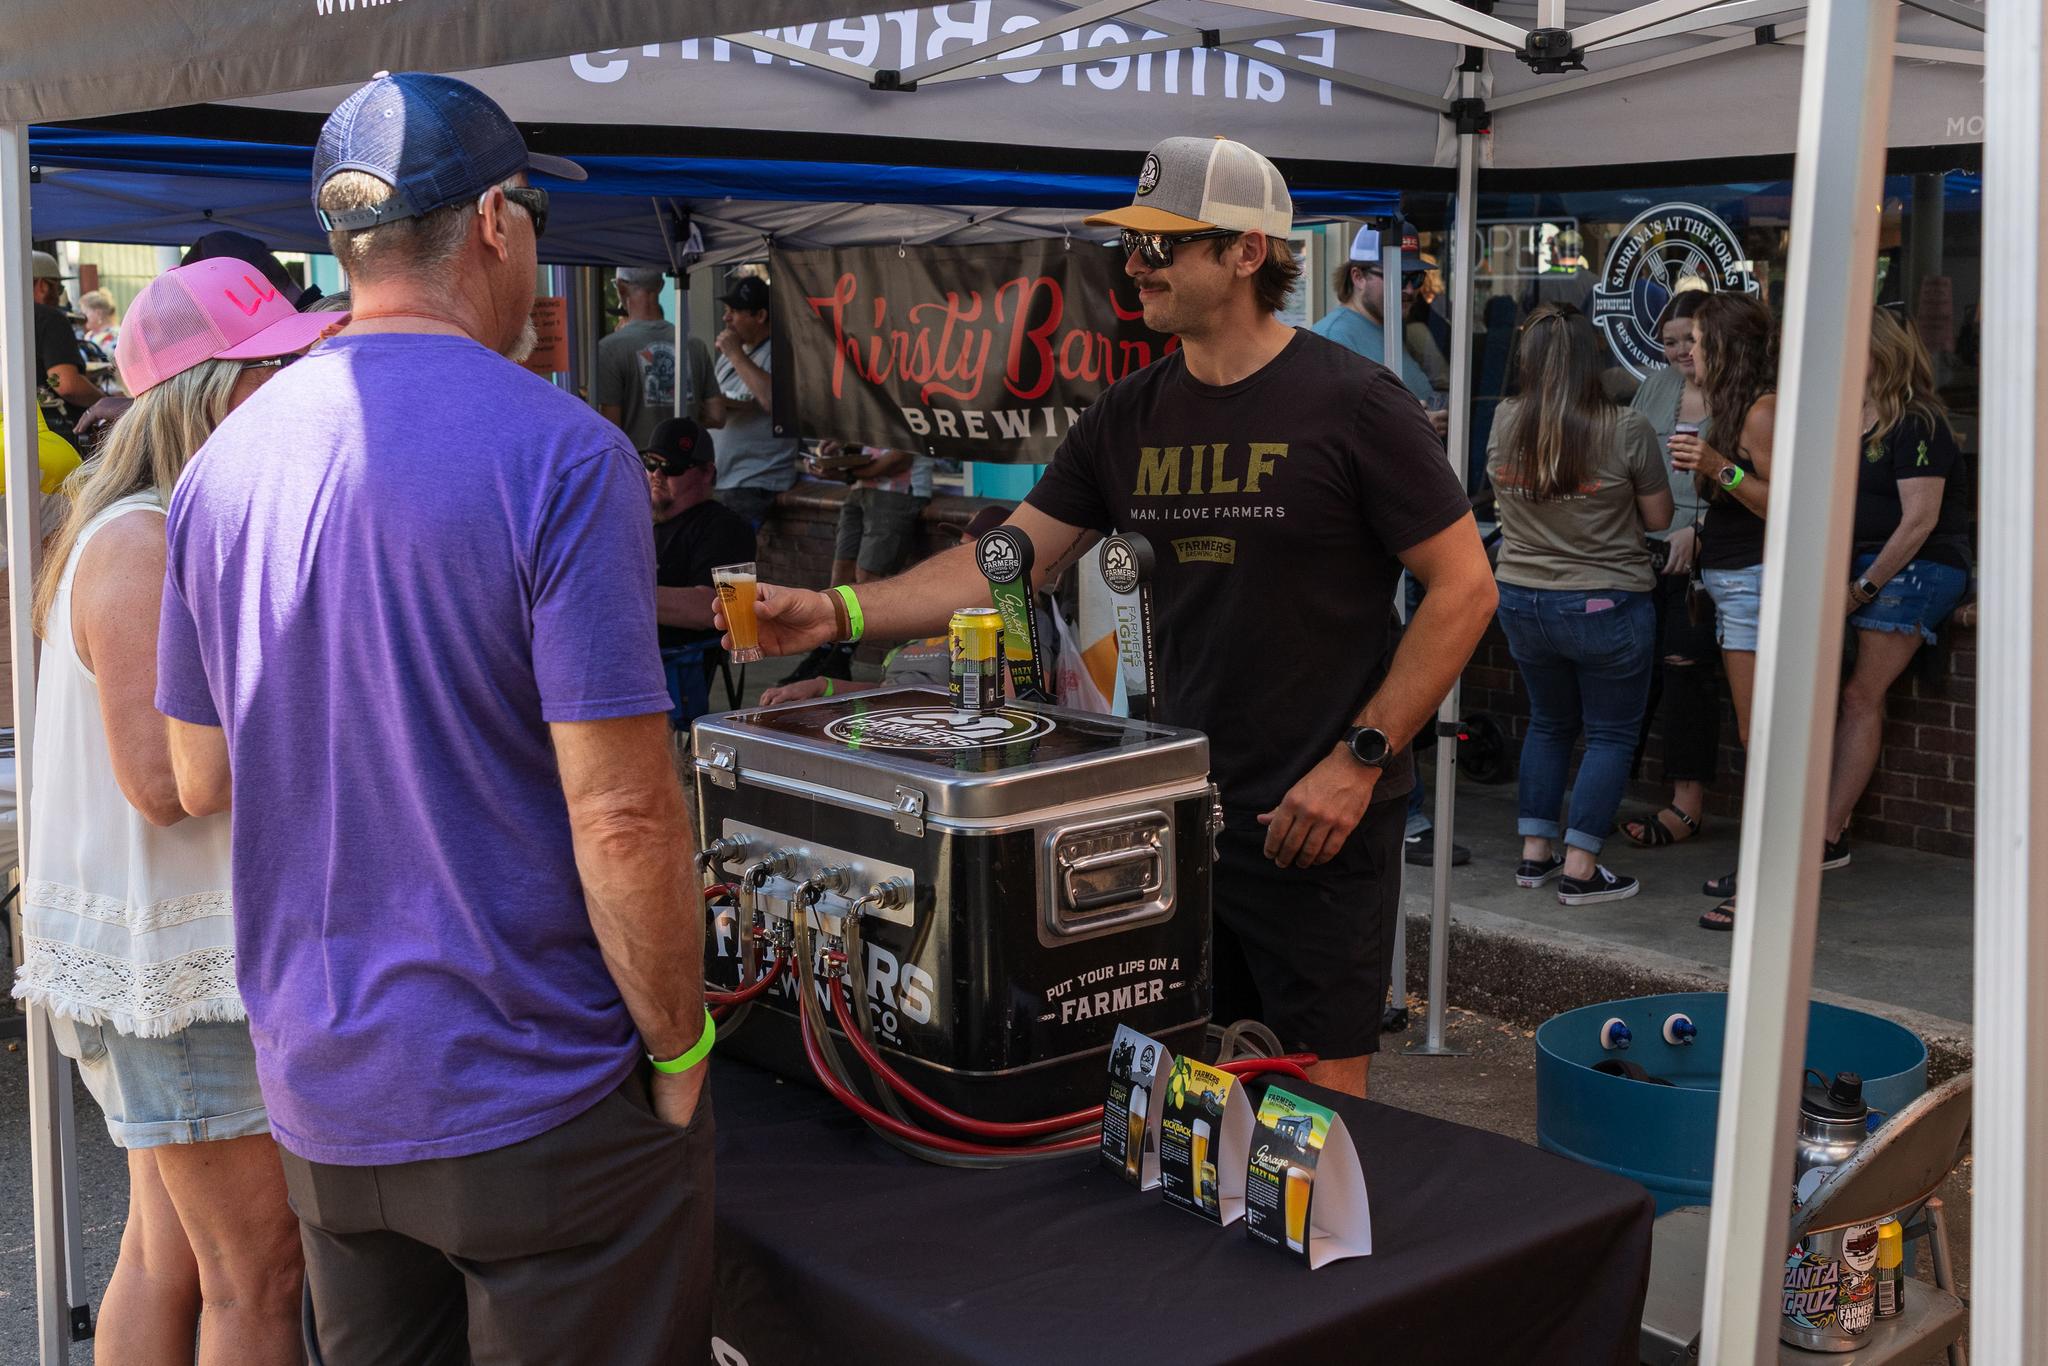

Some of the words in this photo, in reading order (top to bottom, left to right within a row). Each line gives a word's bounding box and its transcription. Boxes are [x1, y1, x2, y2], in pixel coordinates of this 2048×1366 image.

[1946, 116, 1984, 137] MO
[1612, 219, 1663, 288] SABRINA'S
[1664, 216, 1683, 232] AT
[1684, 217, 1711, 242] THE
[1709, 234, 1740, 287] FORKS
[806, 272, 992, 406] Thirsty
[902, 406, 1087, 439] BREWIN
[1132, 443, 1289, 496] MILF
[1165, 508, 1169, 520] I
[1173, 508, 1210, 520] LOVE
[1214, 506, 1286, 519] FARMERS
[1178, 540, 1232, 553] FARMERS
[983, 559, 1019, 571] FARMERS
[1105, 568, 1136, 578] FARMERS
[1117, 606, 1134, 667] LIGHT
[1127, 606, 1142, 667] FARMERS
[1011, 666, 1032, 676] HAZY
[1014, 675, 1032, 685] IPA
[845, 718, 980, 746] FARMERS
[1046, 979, 1073, 1002] PUT
[1078, 965, 1114, 987] YOUR
[1119, 959, 1145, 976] LIPS
[1149, 958, 1168, 971] ON
[1170, 958, 1180, 971] A
[1061, 978, 1165, 1025] FARMER
[1194, 1069, 1220, 1085] FARMERS
[1267, 1093, 1297, 1111] FARMERS
[1251, 1145, 1289, 1173] Garage
[1249, 1164, 1267, 1179] HAZY
[1268, 1172, 1279, 1185] IPA
[1782, 1287, 1838, 1315] CRUZ
[1843, 1314, 1871, 1330] MARKET
